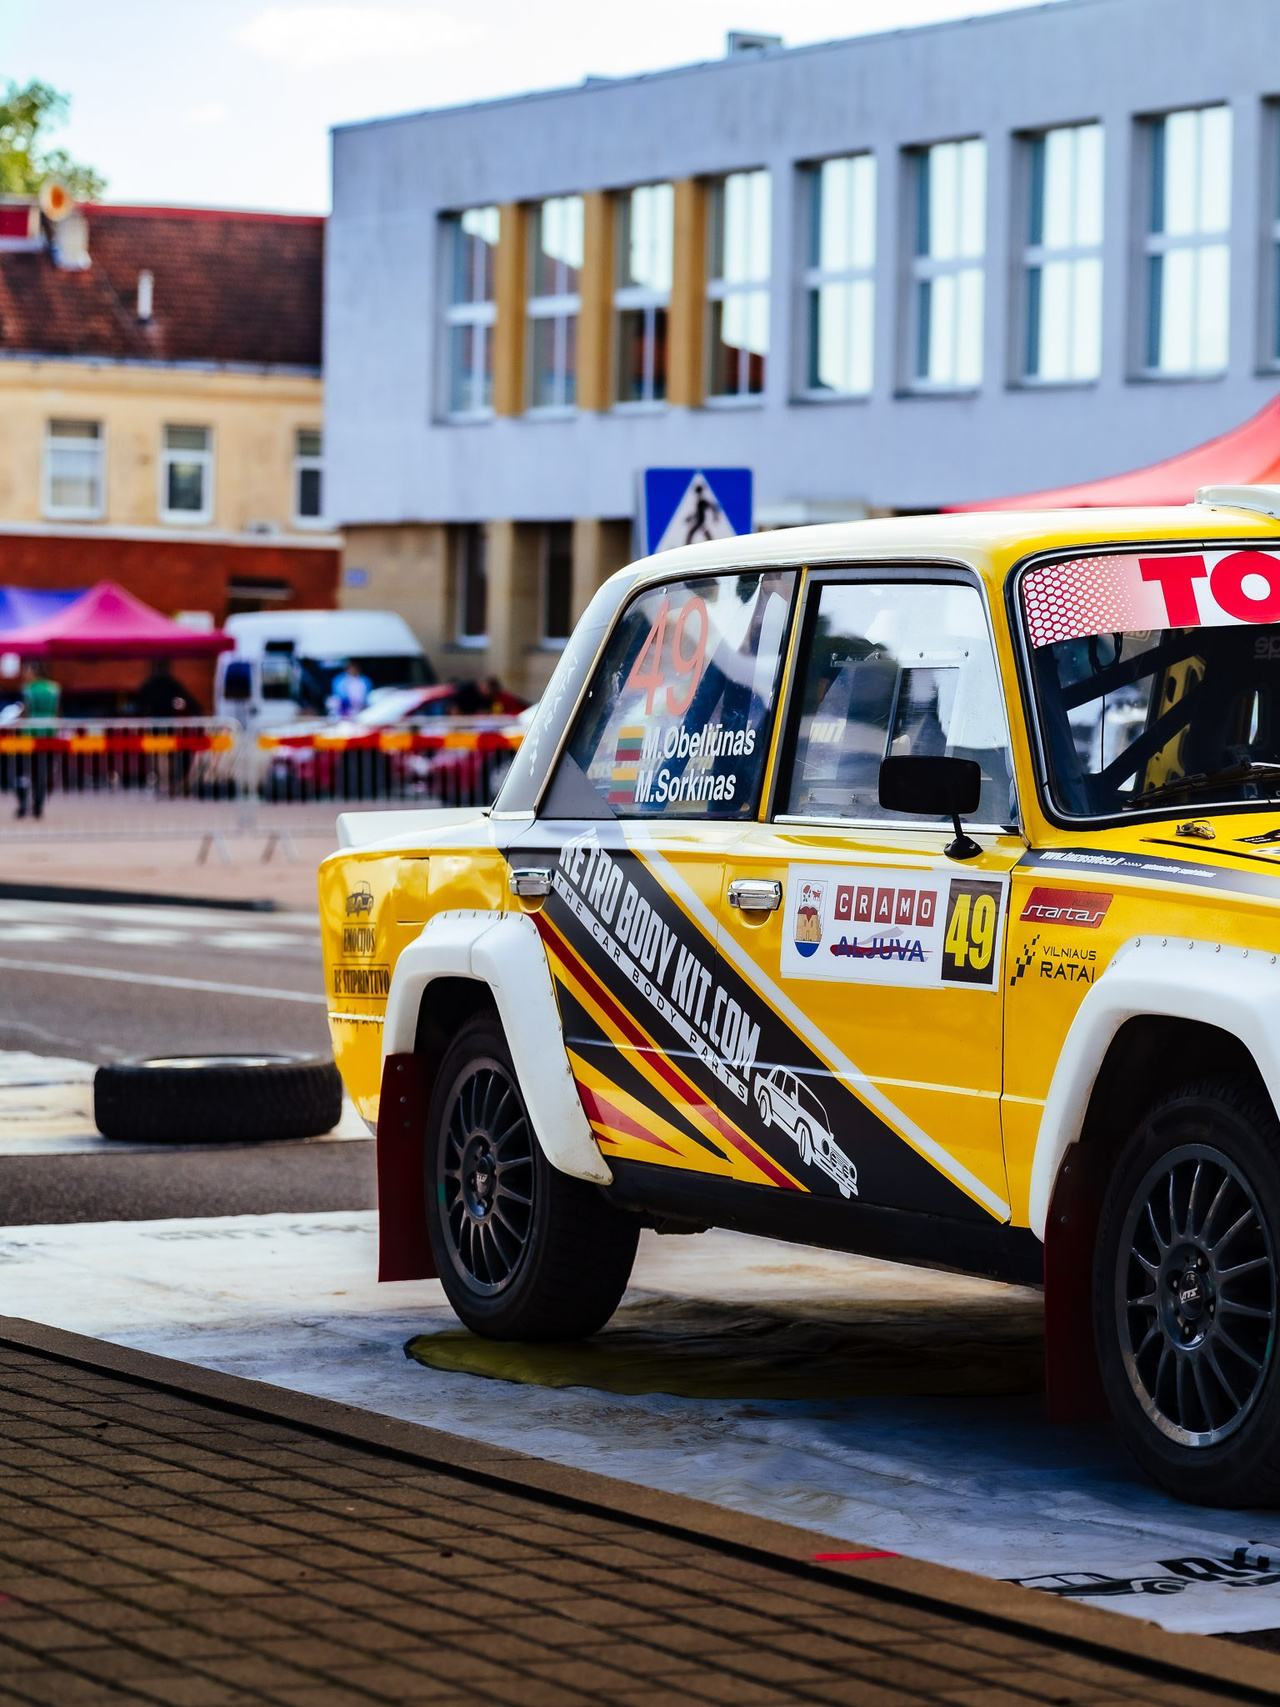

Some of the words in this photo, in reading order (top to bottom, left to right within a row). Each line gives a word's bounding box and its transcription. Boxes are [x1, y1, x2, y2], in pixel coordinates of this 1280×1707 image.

[627, 597, 709, 716] 49
[634, 768, 737, 803] M.Sorkinas
[838, 893, 932, 920] CRAMO
[1020, 903, 1106, 922] startas
[945, 893, 997, 970] 49
[558, 827, 624, 925] RETRO
[614, 881, 678, 987] BODY
[671, 944, 761, 1081] KIT.COM
[834, 935, 926, 963] ALJUVA
[1043, 945, 1097, 960] VILNIAUS
[556, 876, 583, 916] THE
[592, 923, 621, 963] CAR
[632, 967, 678, 1023] BODY
[690, 1031, 746, 1100] PARTS
[1040, 961, 1095, 984] RATAI
